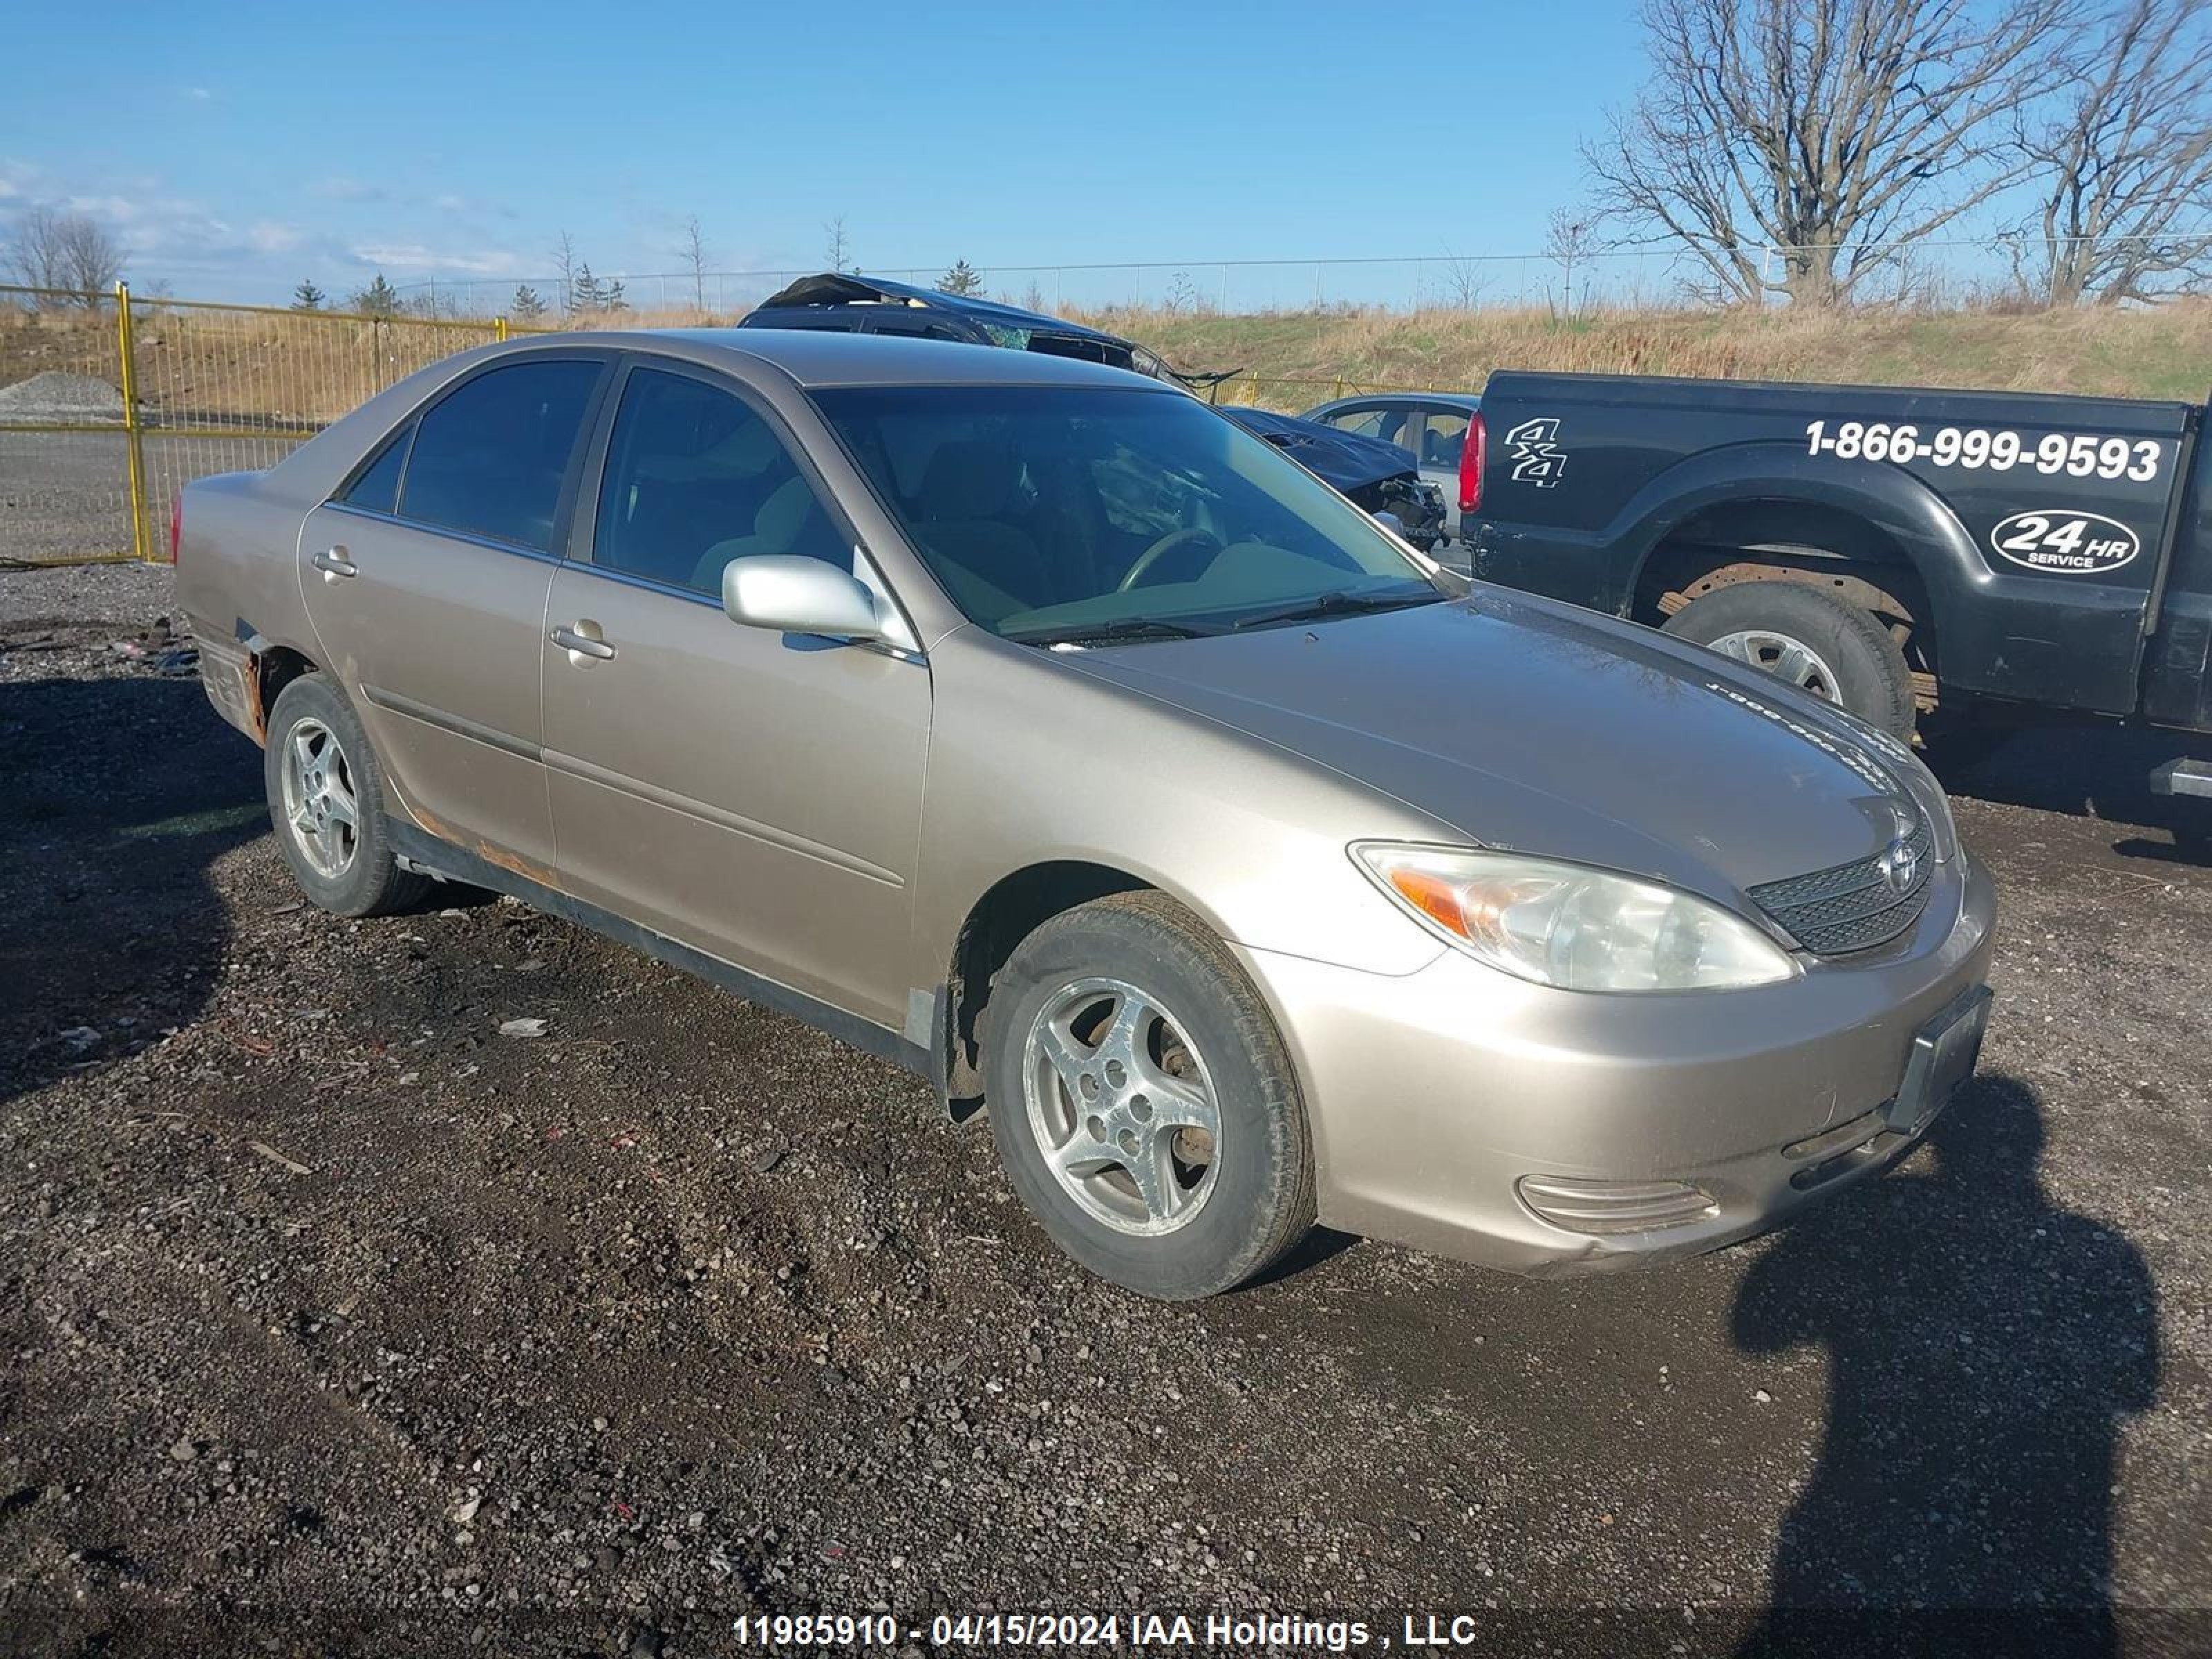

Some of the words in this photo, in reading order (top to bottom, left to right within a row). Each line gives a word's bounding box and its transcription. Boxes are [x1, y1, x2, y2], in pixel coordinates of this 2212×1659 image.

[1806, 420, 2161, 482] 1-866-999-9593
[2003, 516, 2088, 554] 24
[2083, 538, 2130, 559] HR
[2027, 552, 2094, 568] SERVICE
